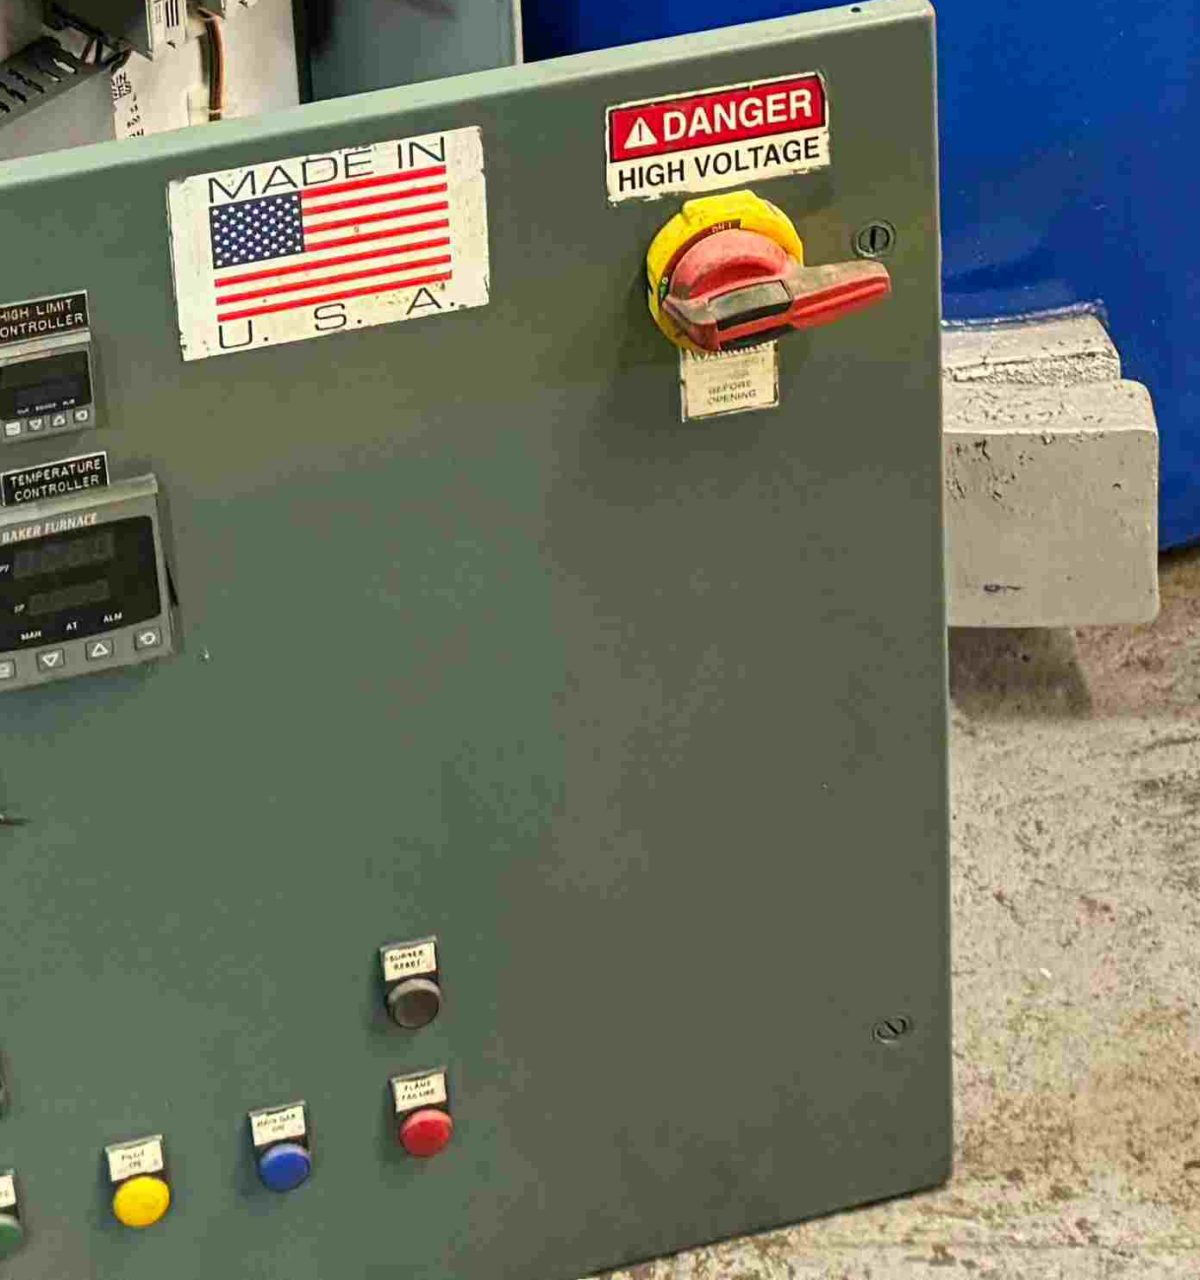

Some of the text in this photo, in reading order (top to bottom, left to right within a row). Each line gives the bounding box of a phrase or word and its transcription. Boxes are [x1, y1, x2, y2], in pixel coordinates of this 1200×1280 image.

[663, 89, 813, 142] DANGER
[208, 136, 447, 204] MADE IN
[618, 136, 820, 192] HIGH VOLTAGE
[0, 299, 72, 322] HIGH LIMIT
[0, 313, 83, 339] ONTROLLER
[10, 458, 101, 489] TEMPERATURE
[14, 474, 100, 502] CONTROLLER
[2, 512, 97, 544] BAKER FURNACE
